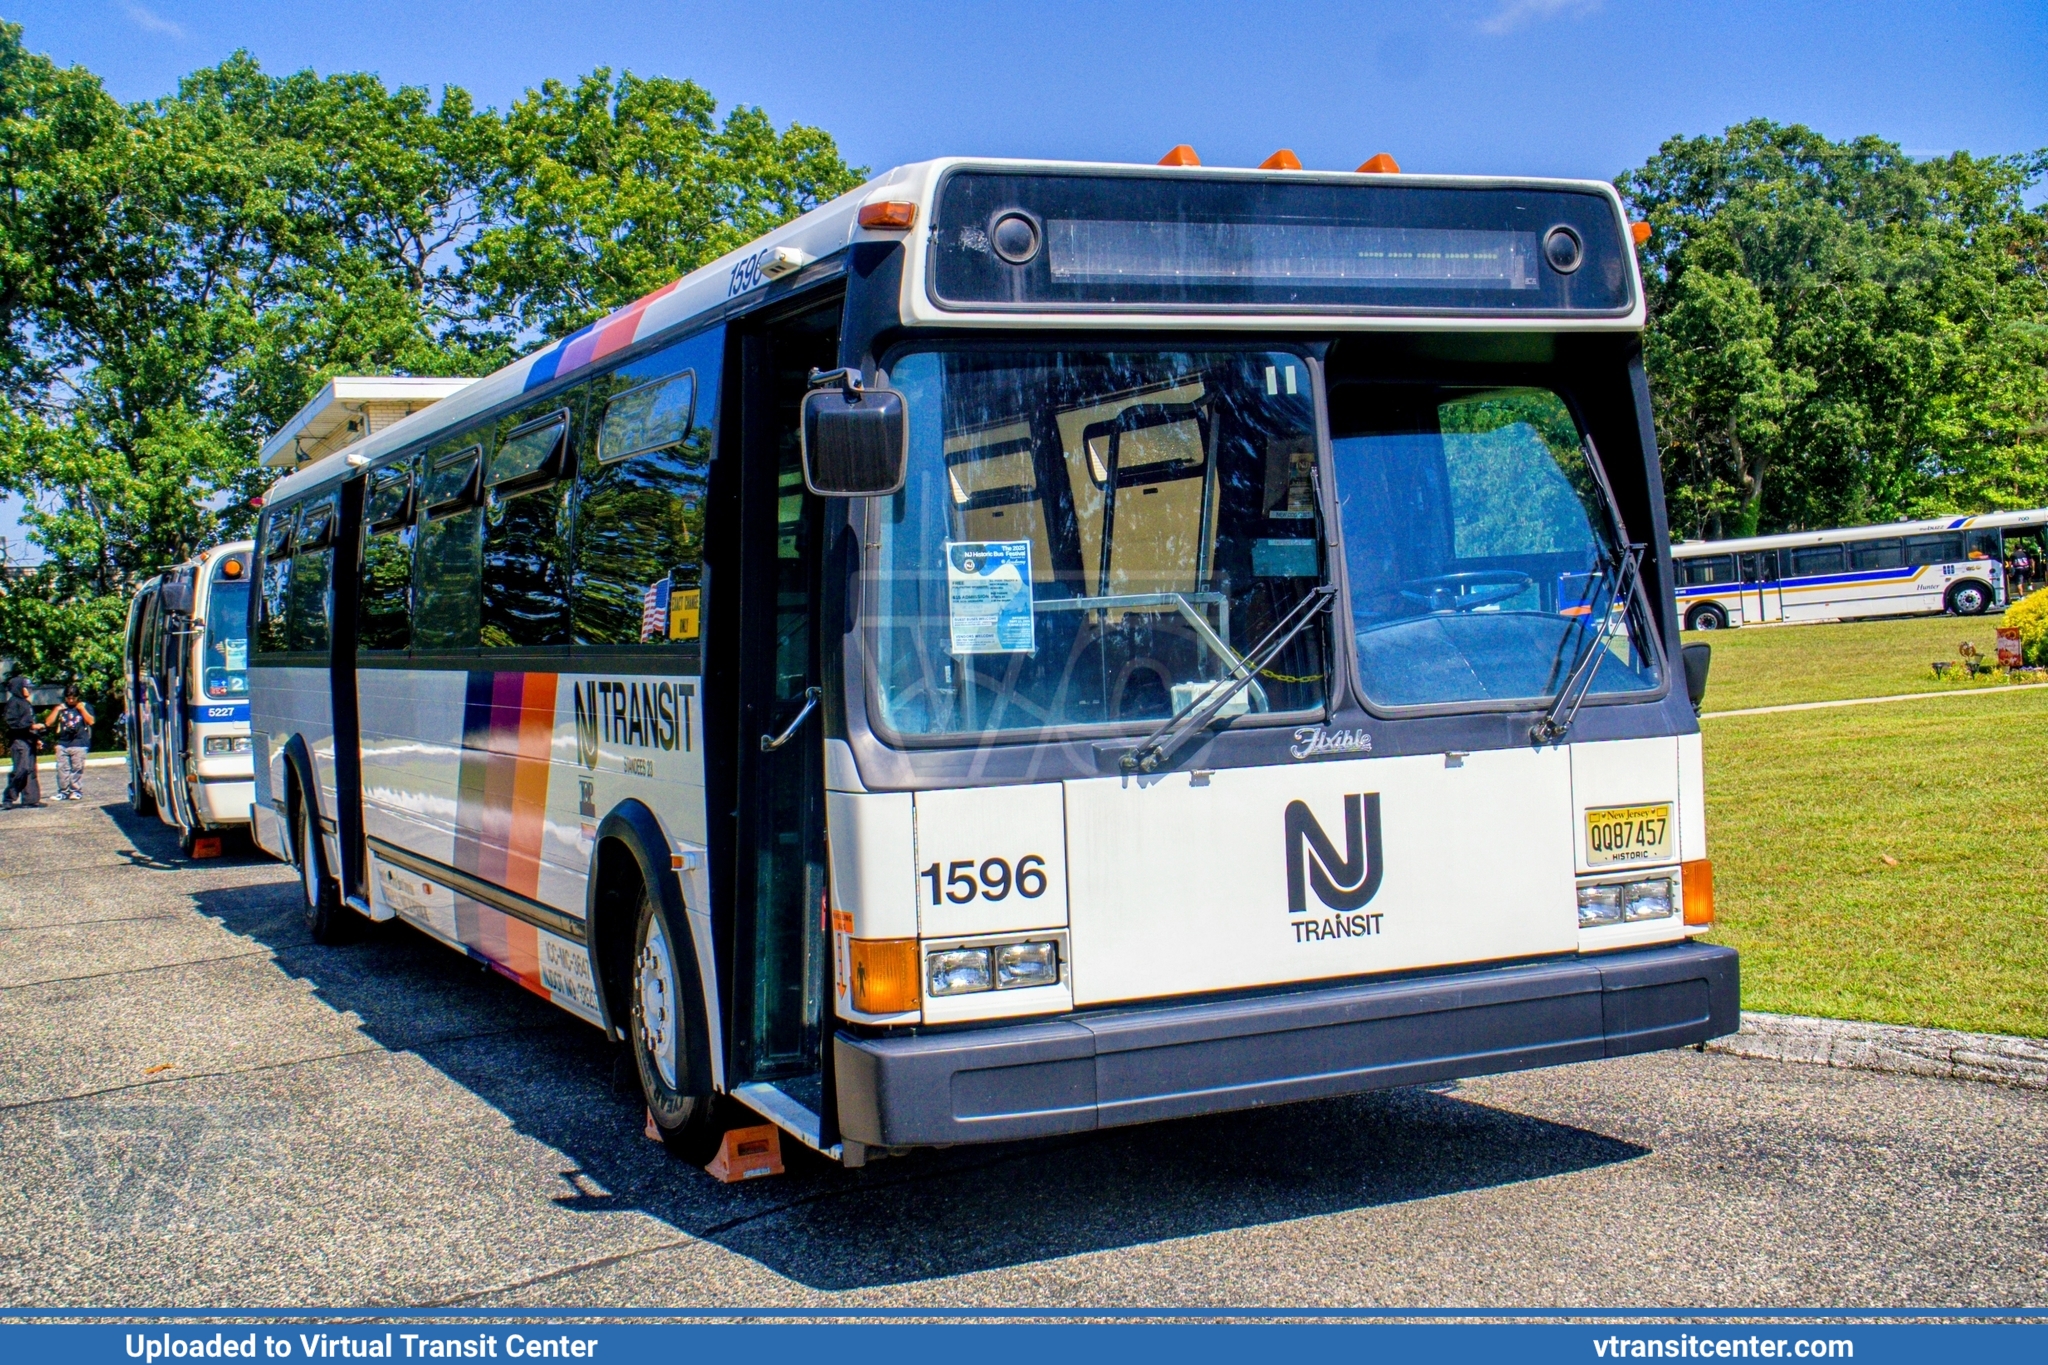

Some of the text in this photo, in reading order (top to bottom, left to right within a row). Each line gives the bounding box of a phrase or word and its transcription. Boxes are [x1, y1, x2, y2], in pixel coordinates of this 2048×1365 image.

[680, 618, 689, 633] ONLY
[208, 707, 234, 717] 5227
[598, 681, 695, 752] TRANSIT
[1607, 809, 1650, 820] New Jersey
[1284, 791, 1384, 913] NJ
[1612, 850, 1649, 861] HISTORIC
[920, 853, 1048, 907] 1596
[1291, 912, 1384, 943] TRANSIT
